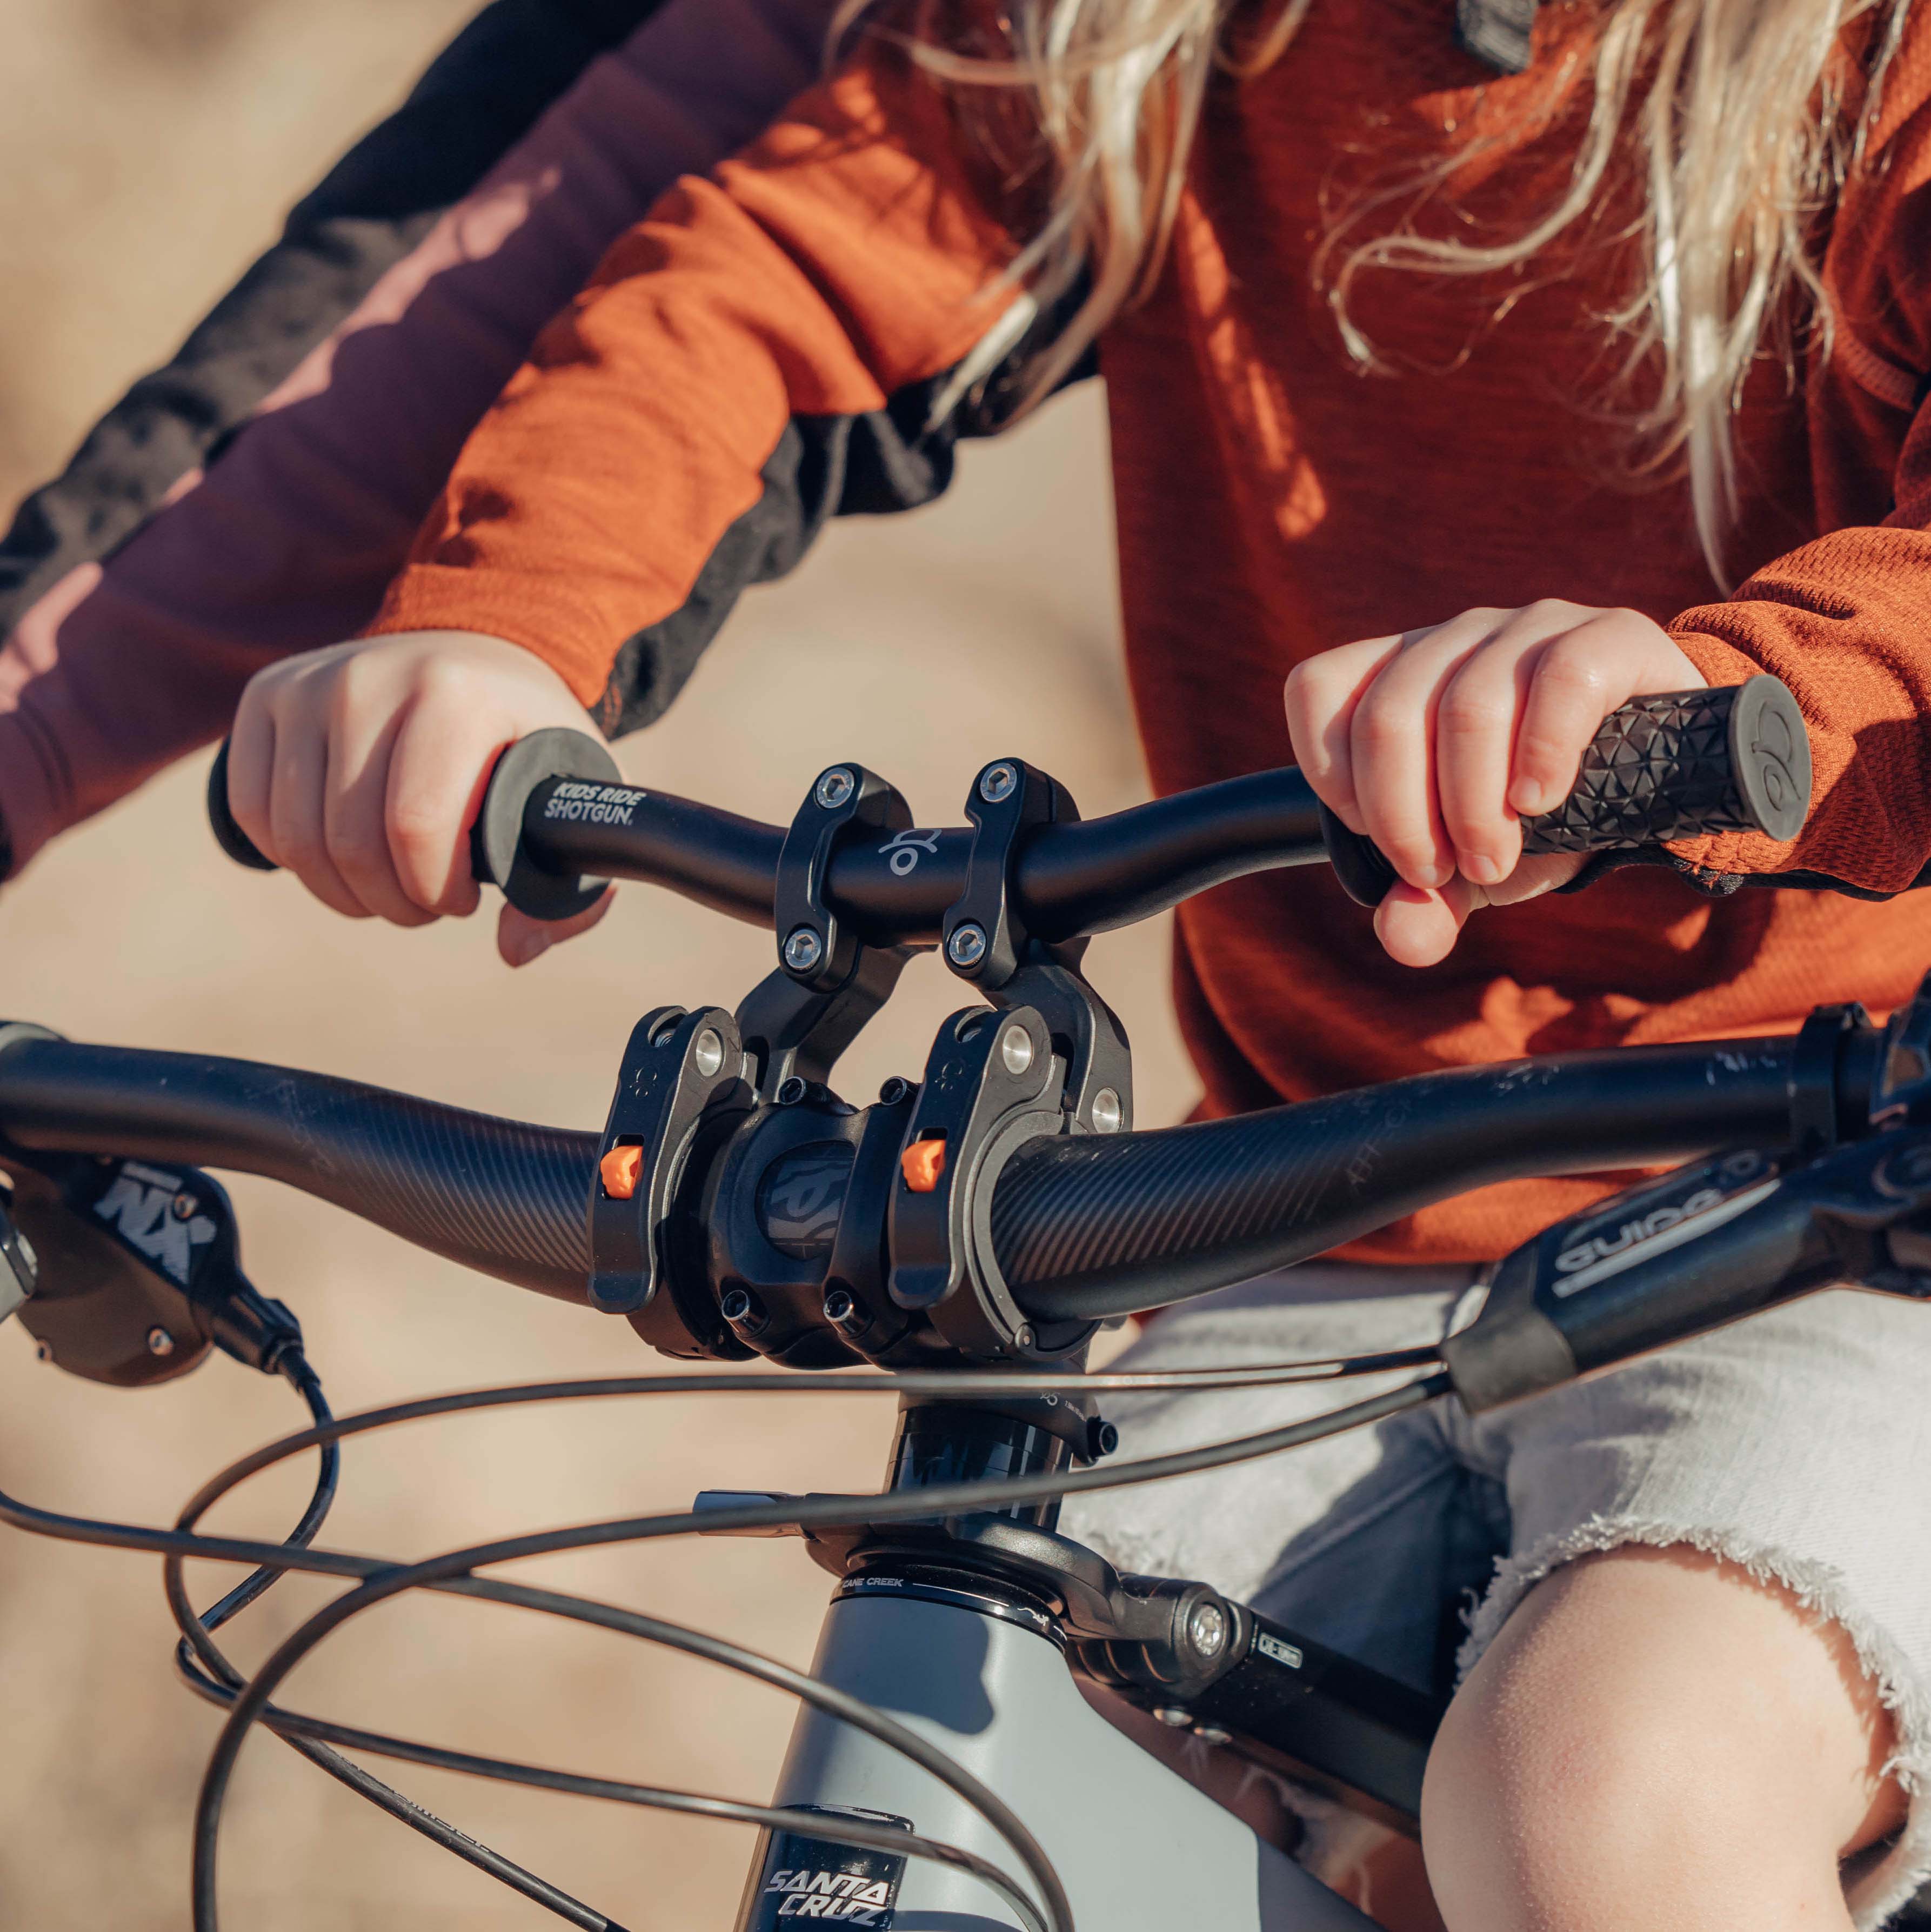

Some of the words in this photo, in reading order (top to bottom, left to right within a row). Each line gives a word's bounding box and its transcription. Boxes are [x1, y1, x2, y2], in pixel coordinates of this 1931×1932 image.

[553, 783, 601, 800] KIDS
[598, 788, 646, 805] RIDE
[843, 1578, 865, 1588] CANE
[866, 1577, 904, 1587] CREEK
[764, 1870, 890, 1905] SANTA
[778, 1894, 886, 1927] CRUZ
